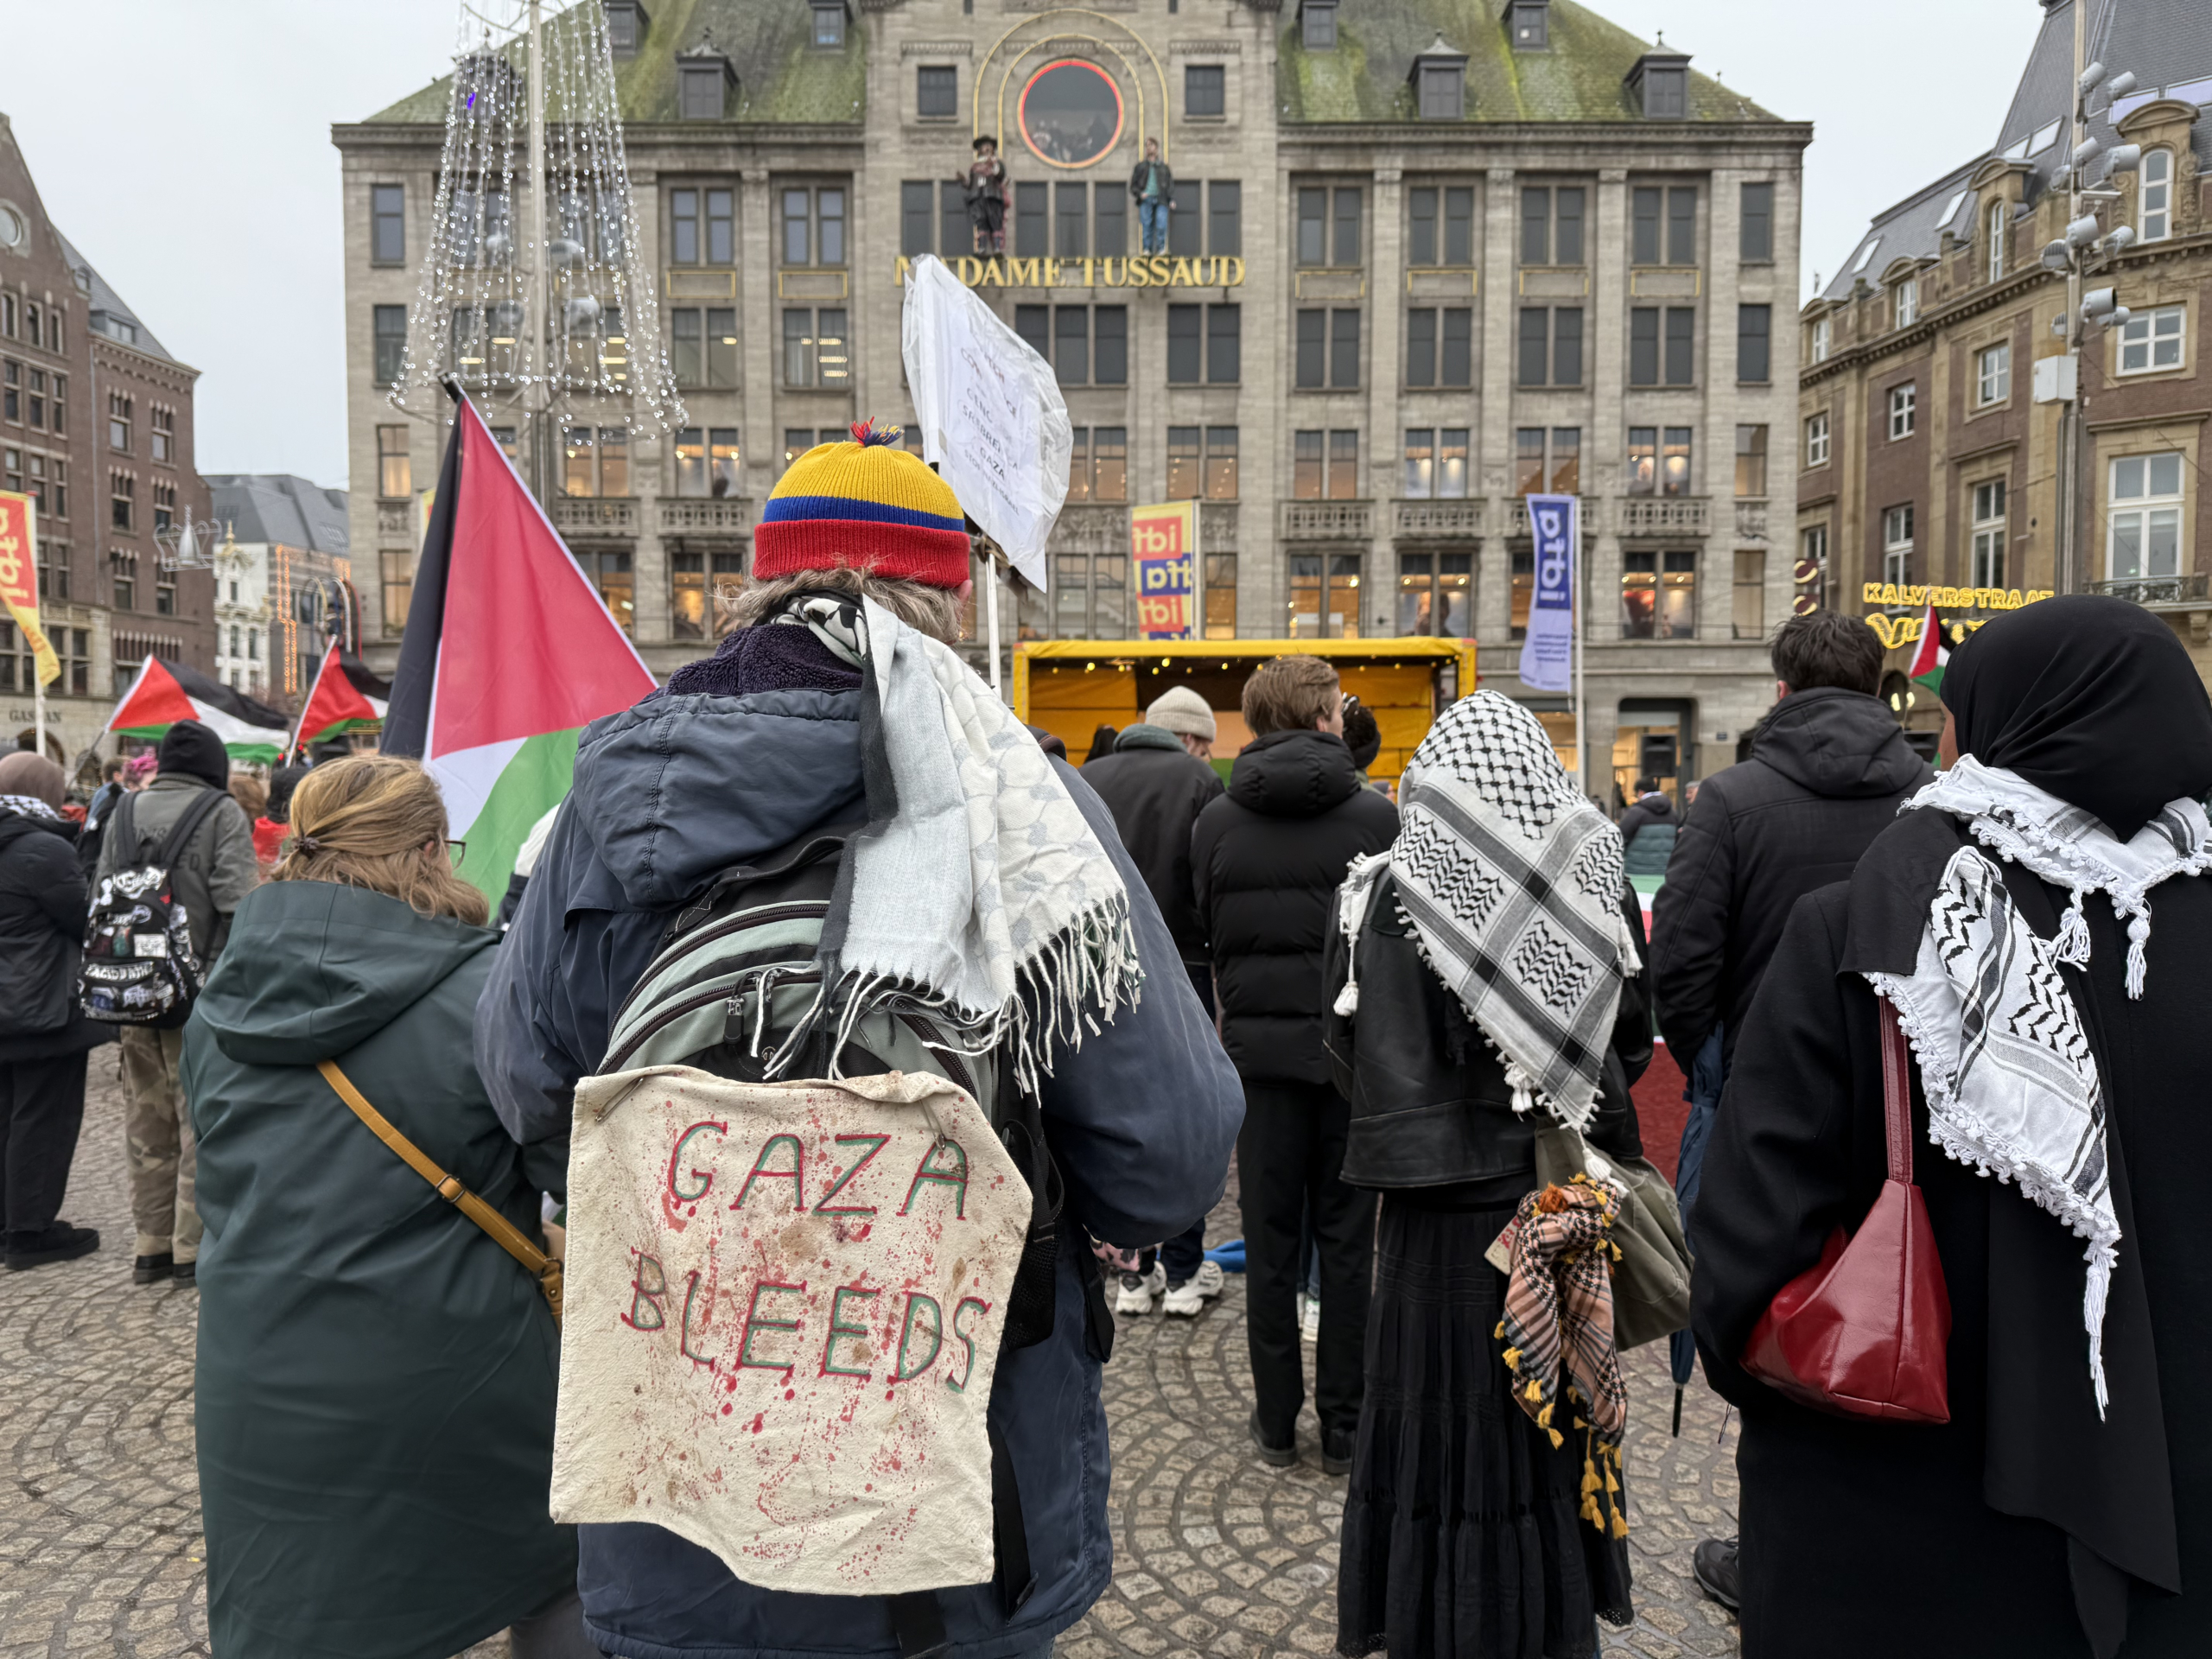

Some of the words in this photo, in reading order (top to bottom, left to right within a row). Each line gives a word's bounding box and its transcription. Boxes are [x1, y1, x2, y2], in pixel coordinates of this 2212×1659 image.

[894, 256, 1065, 287] DAME
[1076, 256, 1246, 287] TUSSAUD
[980, 446, 1005, 480] GAZA
[9, 709, 62, 723] GASAN
[667, 1120, 969, 1220] GAZA
[620, 1247, 992, 1393] BLEEDS
